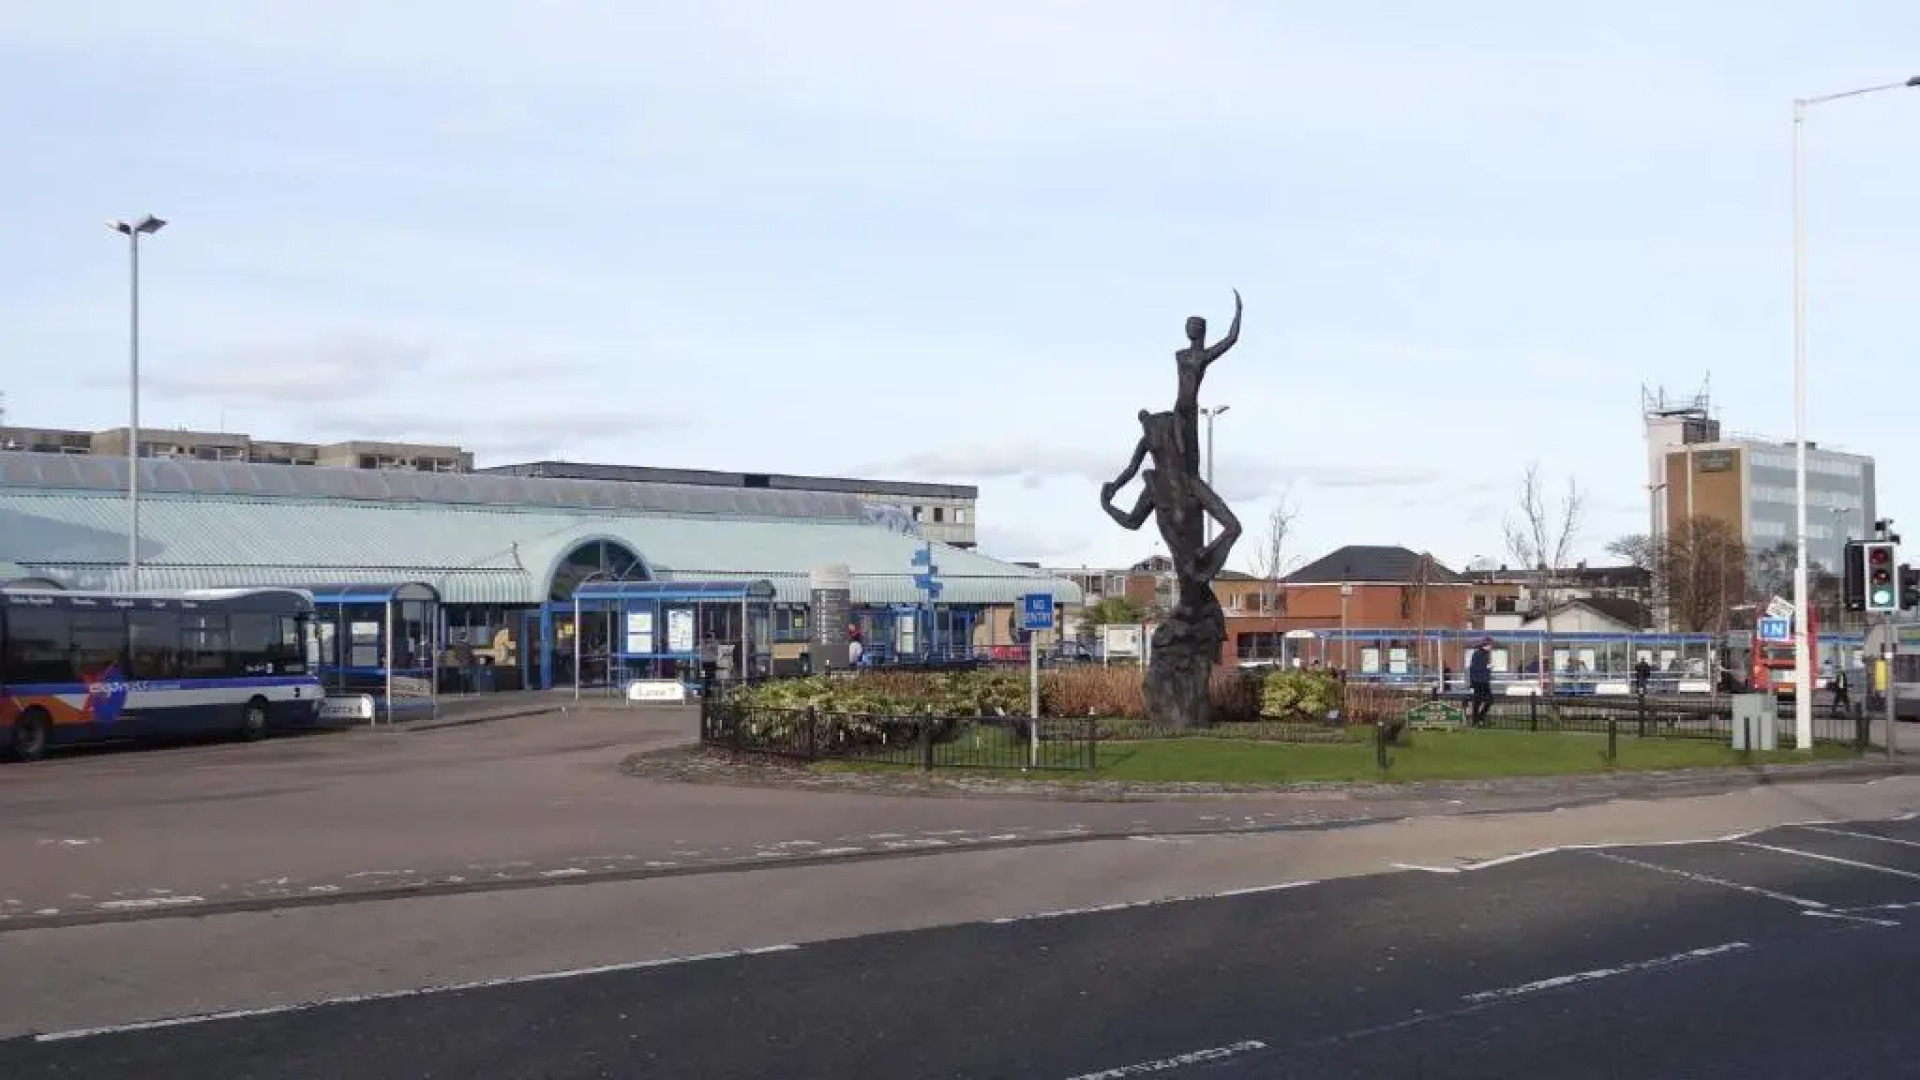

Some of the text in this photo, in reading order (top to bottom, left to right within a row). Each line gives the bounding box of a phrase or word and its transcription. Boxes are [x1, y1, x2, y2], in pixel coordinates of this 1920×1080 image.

[1032, 599, 1045, 610] NO
[1027, 611, 1050, 623] ENTRY
[1763, 623, 1784, 635] IN
